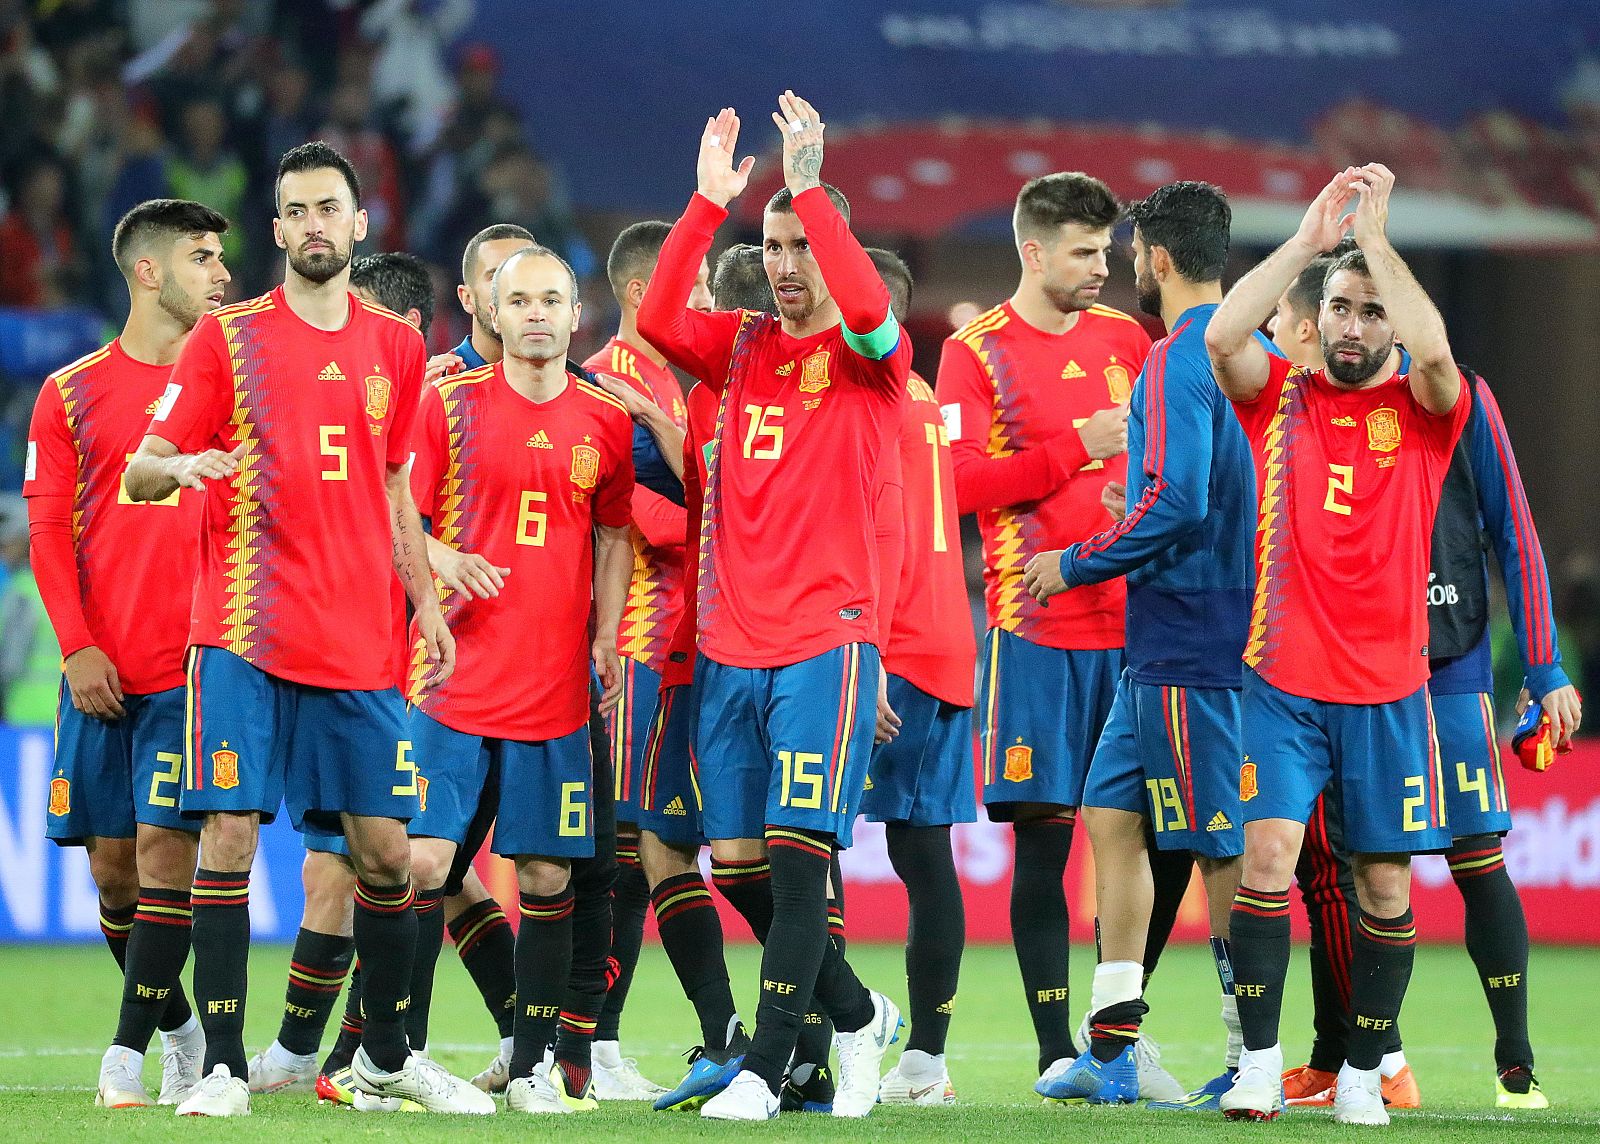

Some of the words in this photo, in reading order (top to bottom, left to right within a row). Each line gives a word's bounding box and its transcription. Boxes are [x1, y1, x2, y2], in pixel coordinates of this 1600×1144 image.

[319, 425, 349, 481] 5
[526, 441, 554, 450] adidas
[743, 404, 785, 460] 15
[1323, 463, 1354, 516] 2
[516, 491, 547, 547] 6
[148, 752, 182, 807] 2
[392, 741, 418, 796] 5
[777, 751, 824, 810] 15
[1456, 762, 1490, 813] 4
[558, 782, 586, 837] 6
[663, 808, 687, 816] adidas
[1147, 778, 1188, 833] 19
[1206, 822, 1233, 832] adidas
[1403, 775, 1427, 832] 2
